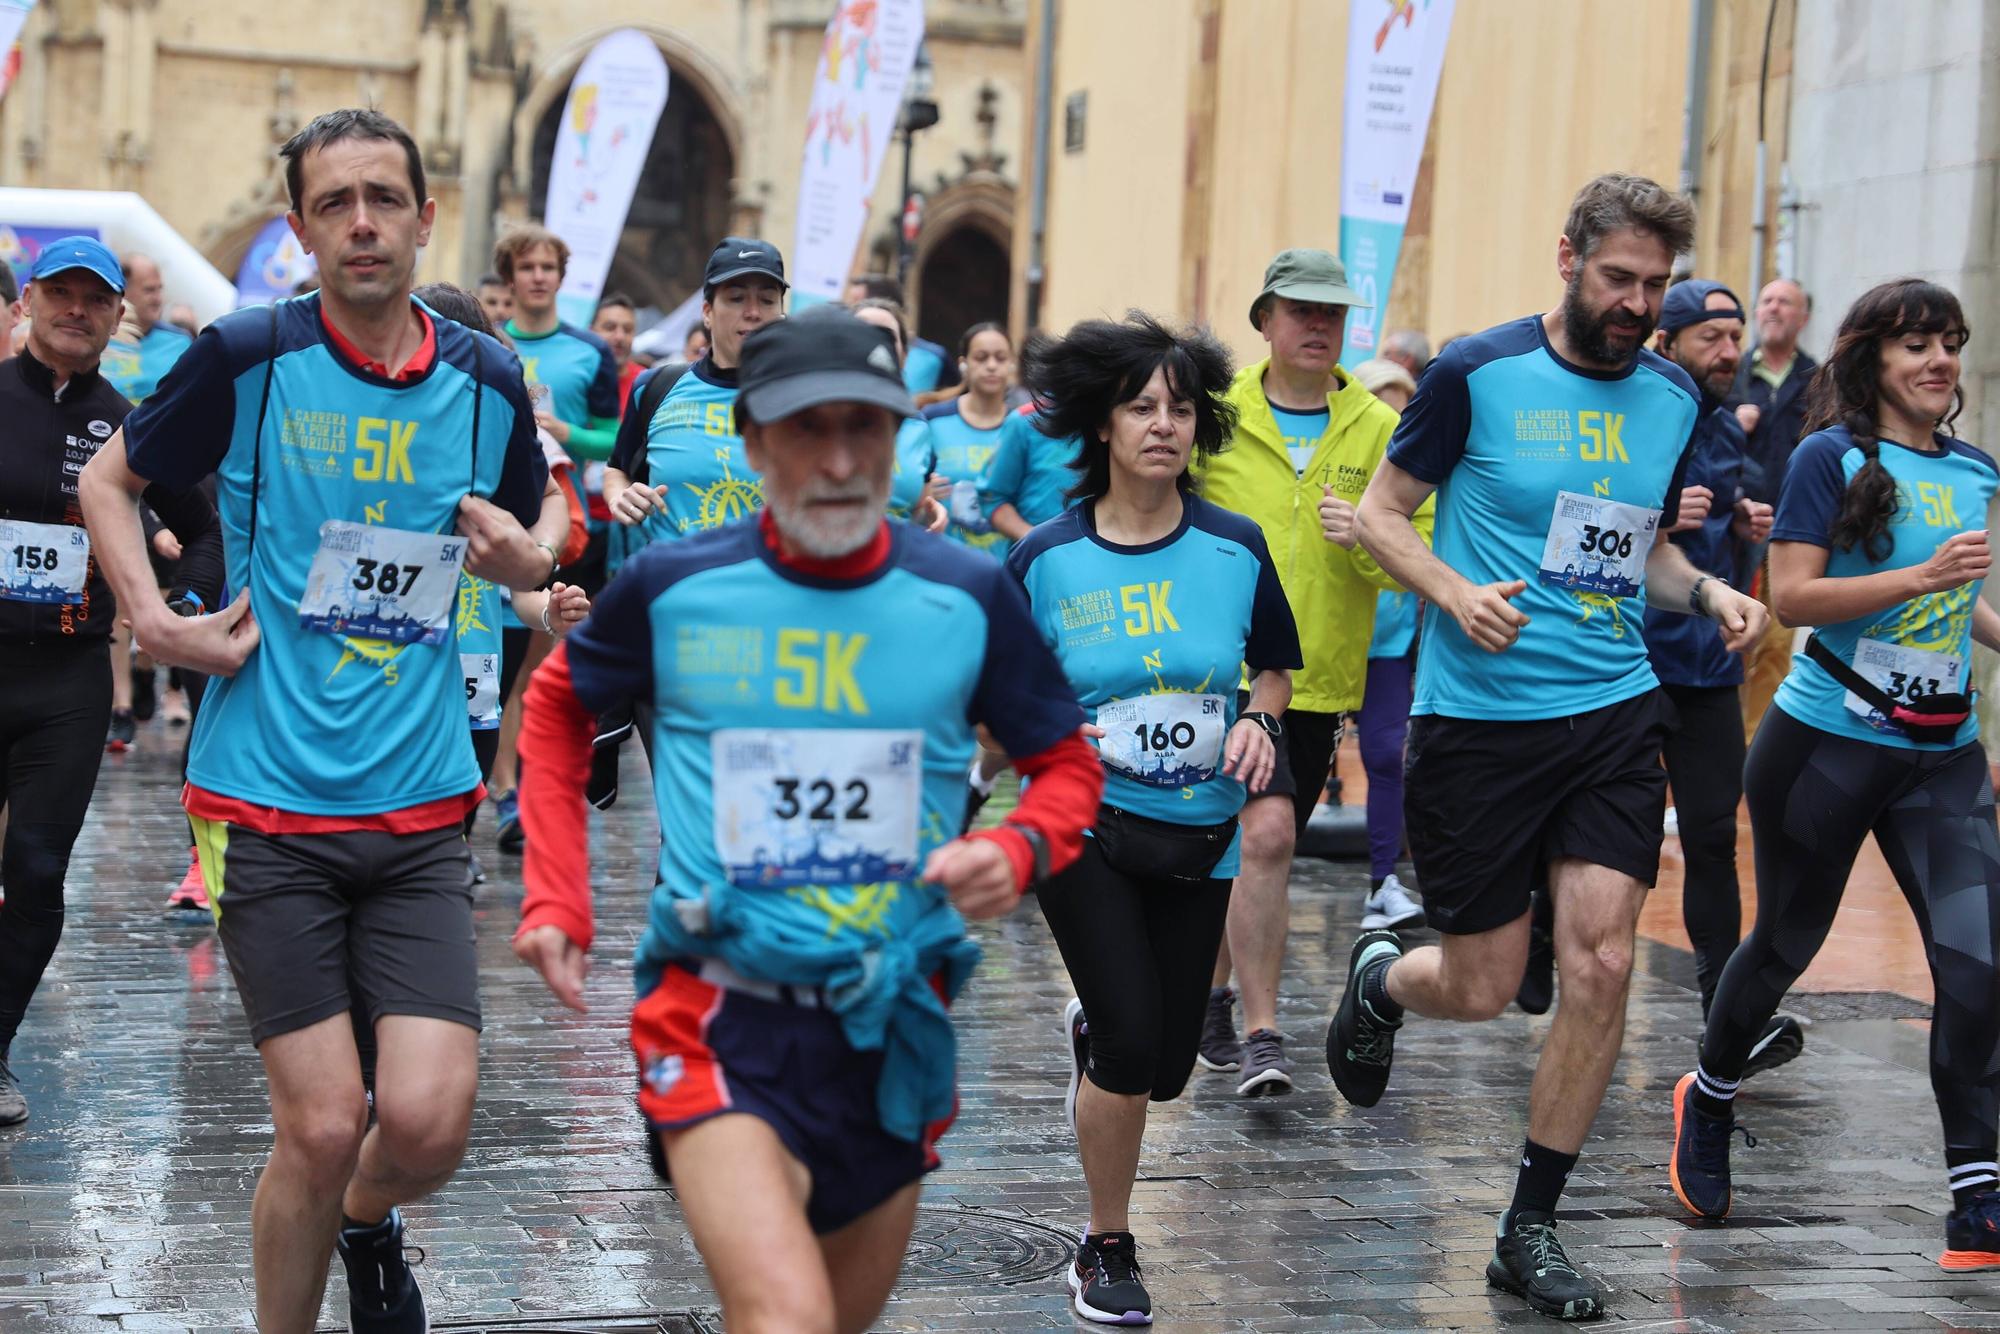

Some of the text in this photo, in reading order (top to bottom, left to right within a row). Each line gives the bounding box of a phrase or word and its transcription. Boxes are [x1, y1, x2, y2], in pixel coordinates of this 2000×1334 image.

[295, 409, 346, 424] CARRERA
[1516, 420, 1570, 430] RUTA POR LA
[1527, 410, 1570, 419] CARRERA
[1516, 431, 1572, 441] SEGURIDAD
[1578, 410, 1631, 464] 5K
[352, 415, 419, 484] 5K
[1917, 481, 1963, 530] 5K
[71, 531, 85, 546] 5K
[1580, 524, 1633, 558] 306
[12, 545, 58, 571] 158
[440, 544, 460, 562] 5K
[352, 557, 424, 597] 387
[369, 593, 398, 604] DAVID
[1070, 588, 1112, 605] CARRERA
[1119, 580, 1181, 637] 5K
[1063, 609, 1116, 631] SEGURIDAD
[773, 627, 870, 716] 5K
[1202, 699, 1218, 714] 5K
[1134, 721, 1196, 752] 160
[772, 778, 871, 820] 322
